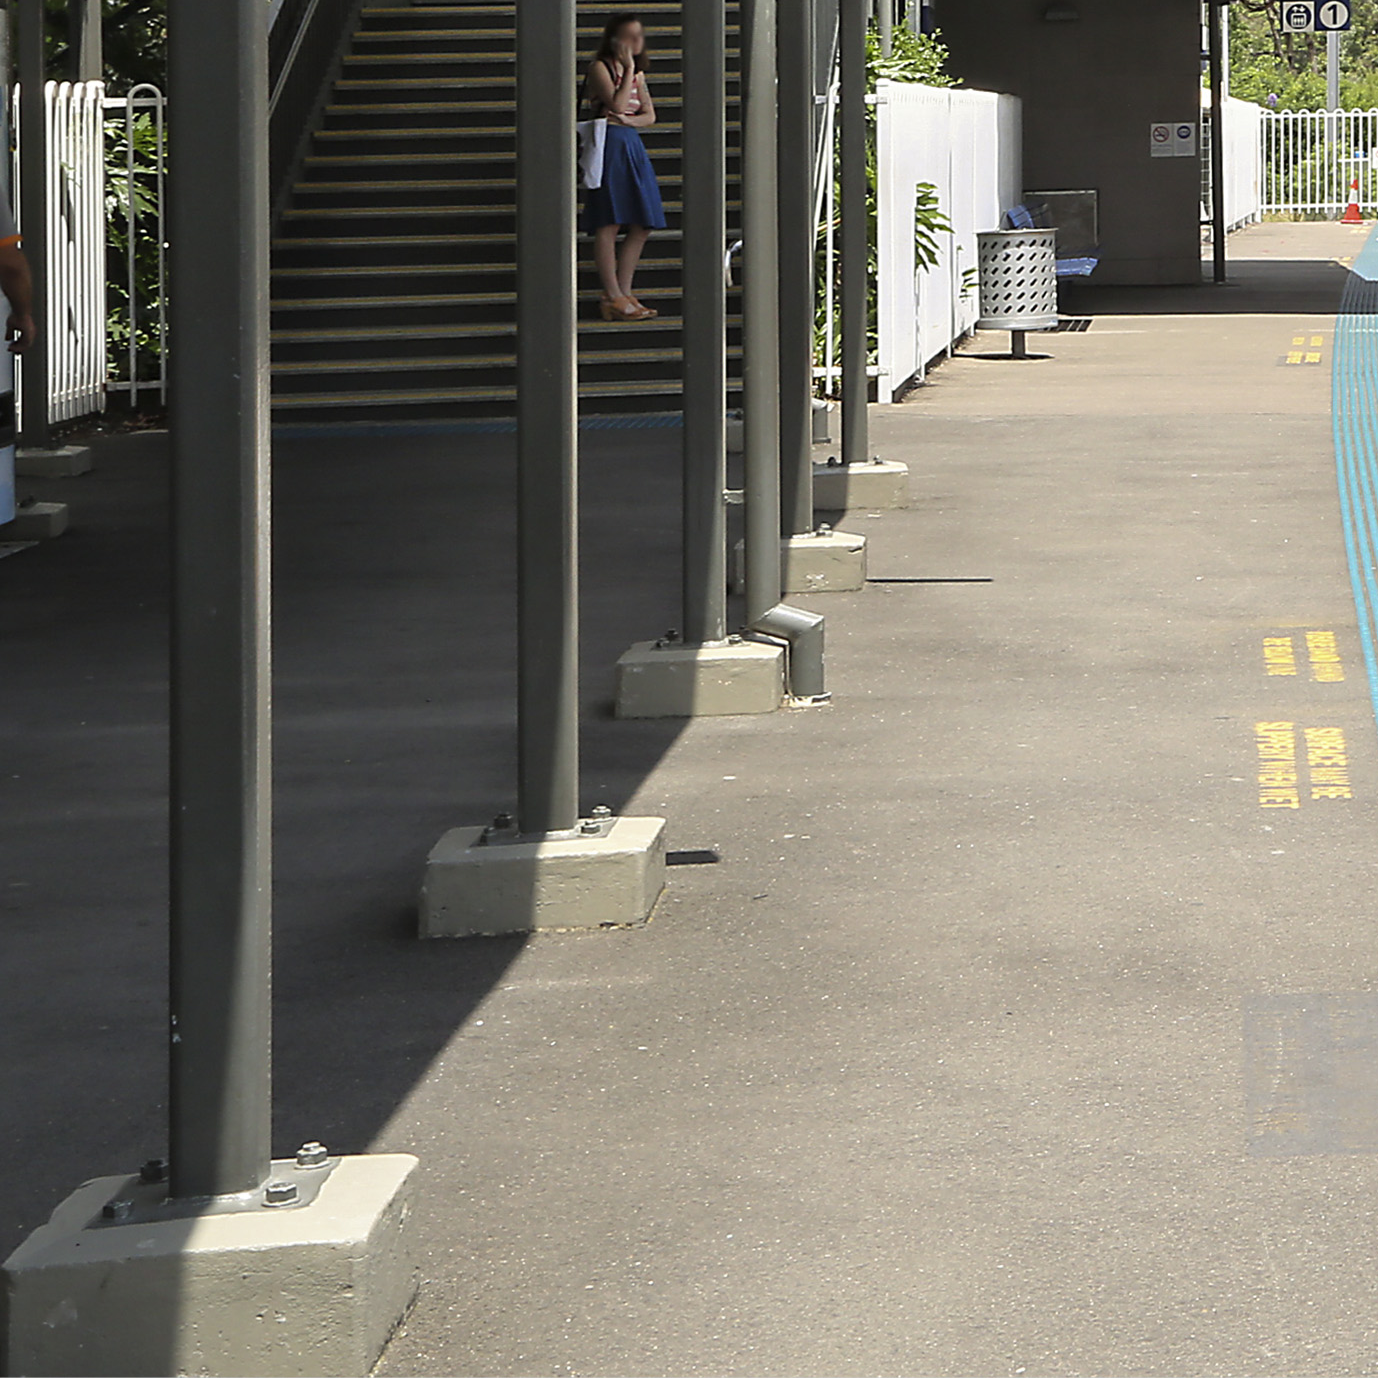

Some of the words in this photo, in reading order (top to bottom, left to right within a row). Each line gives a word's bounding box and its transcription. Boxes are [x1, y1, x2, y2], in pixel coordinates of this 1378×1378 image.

[1327, 4, 1338, 25] 1
[1259, 787, 1300, 810] WET
[1311, 785, 1352, 800] BE
